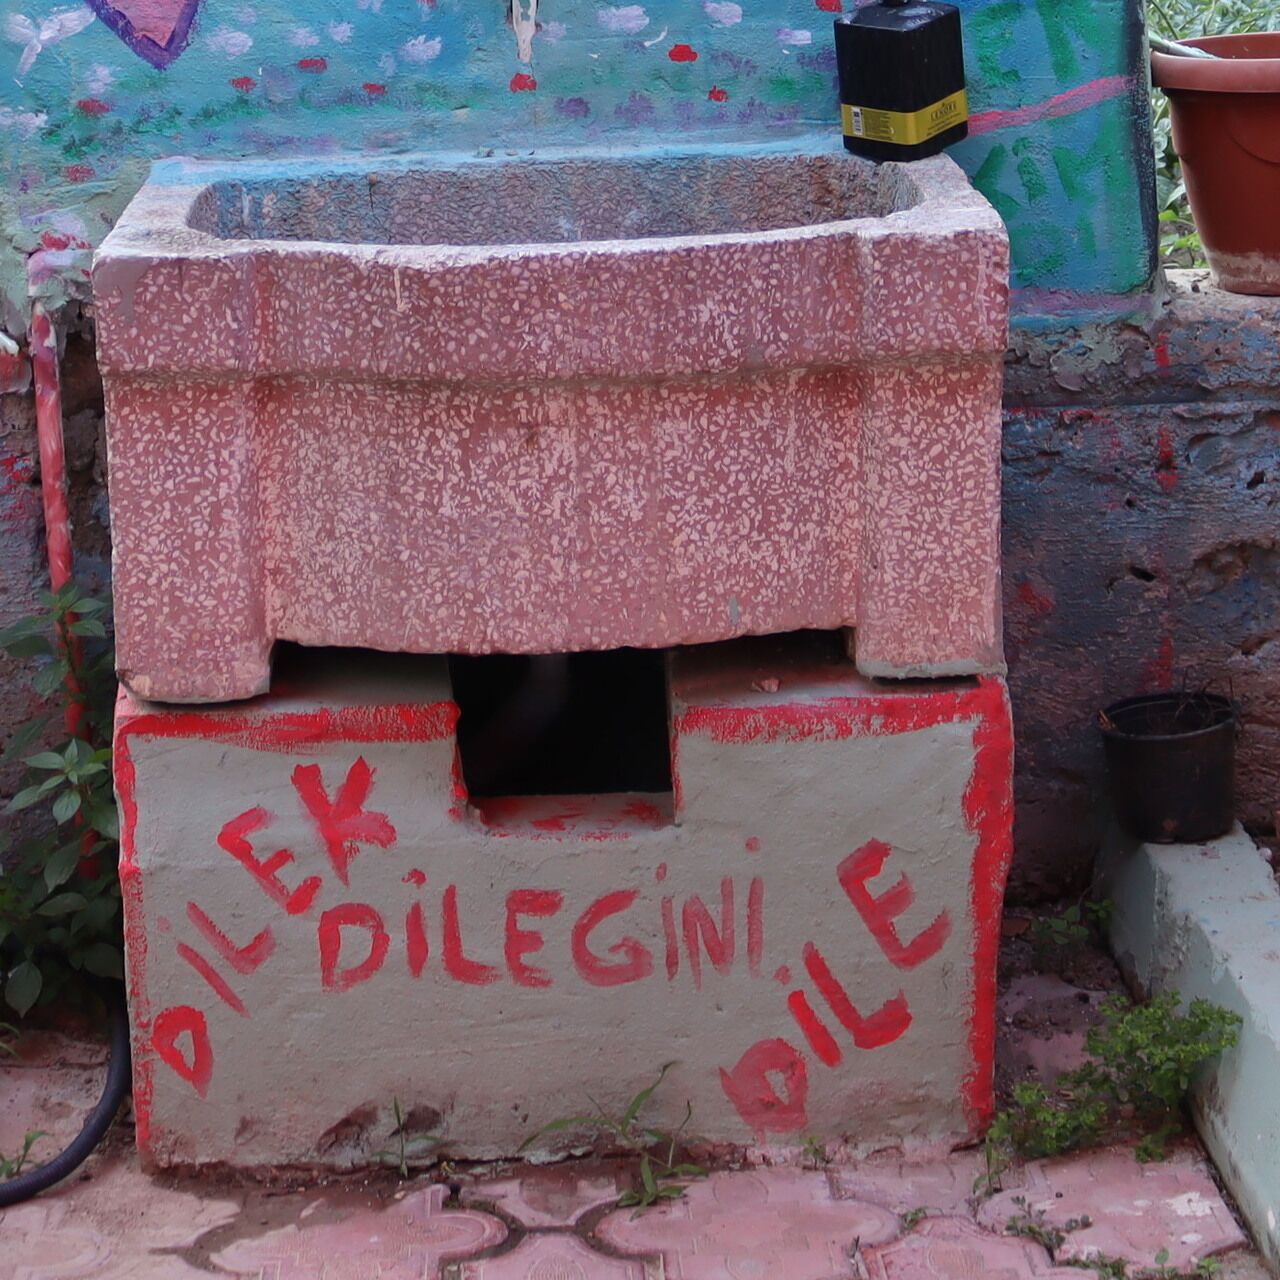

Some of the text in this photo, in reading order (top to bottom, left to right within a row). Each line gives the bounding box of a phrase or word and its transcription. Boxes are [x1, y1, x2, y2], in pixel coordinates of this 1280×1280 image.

[150, 754, 950, 1134] DİLEK DİLEGİNİ DİLE
